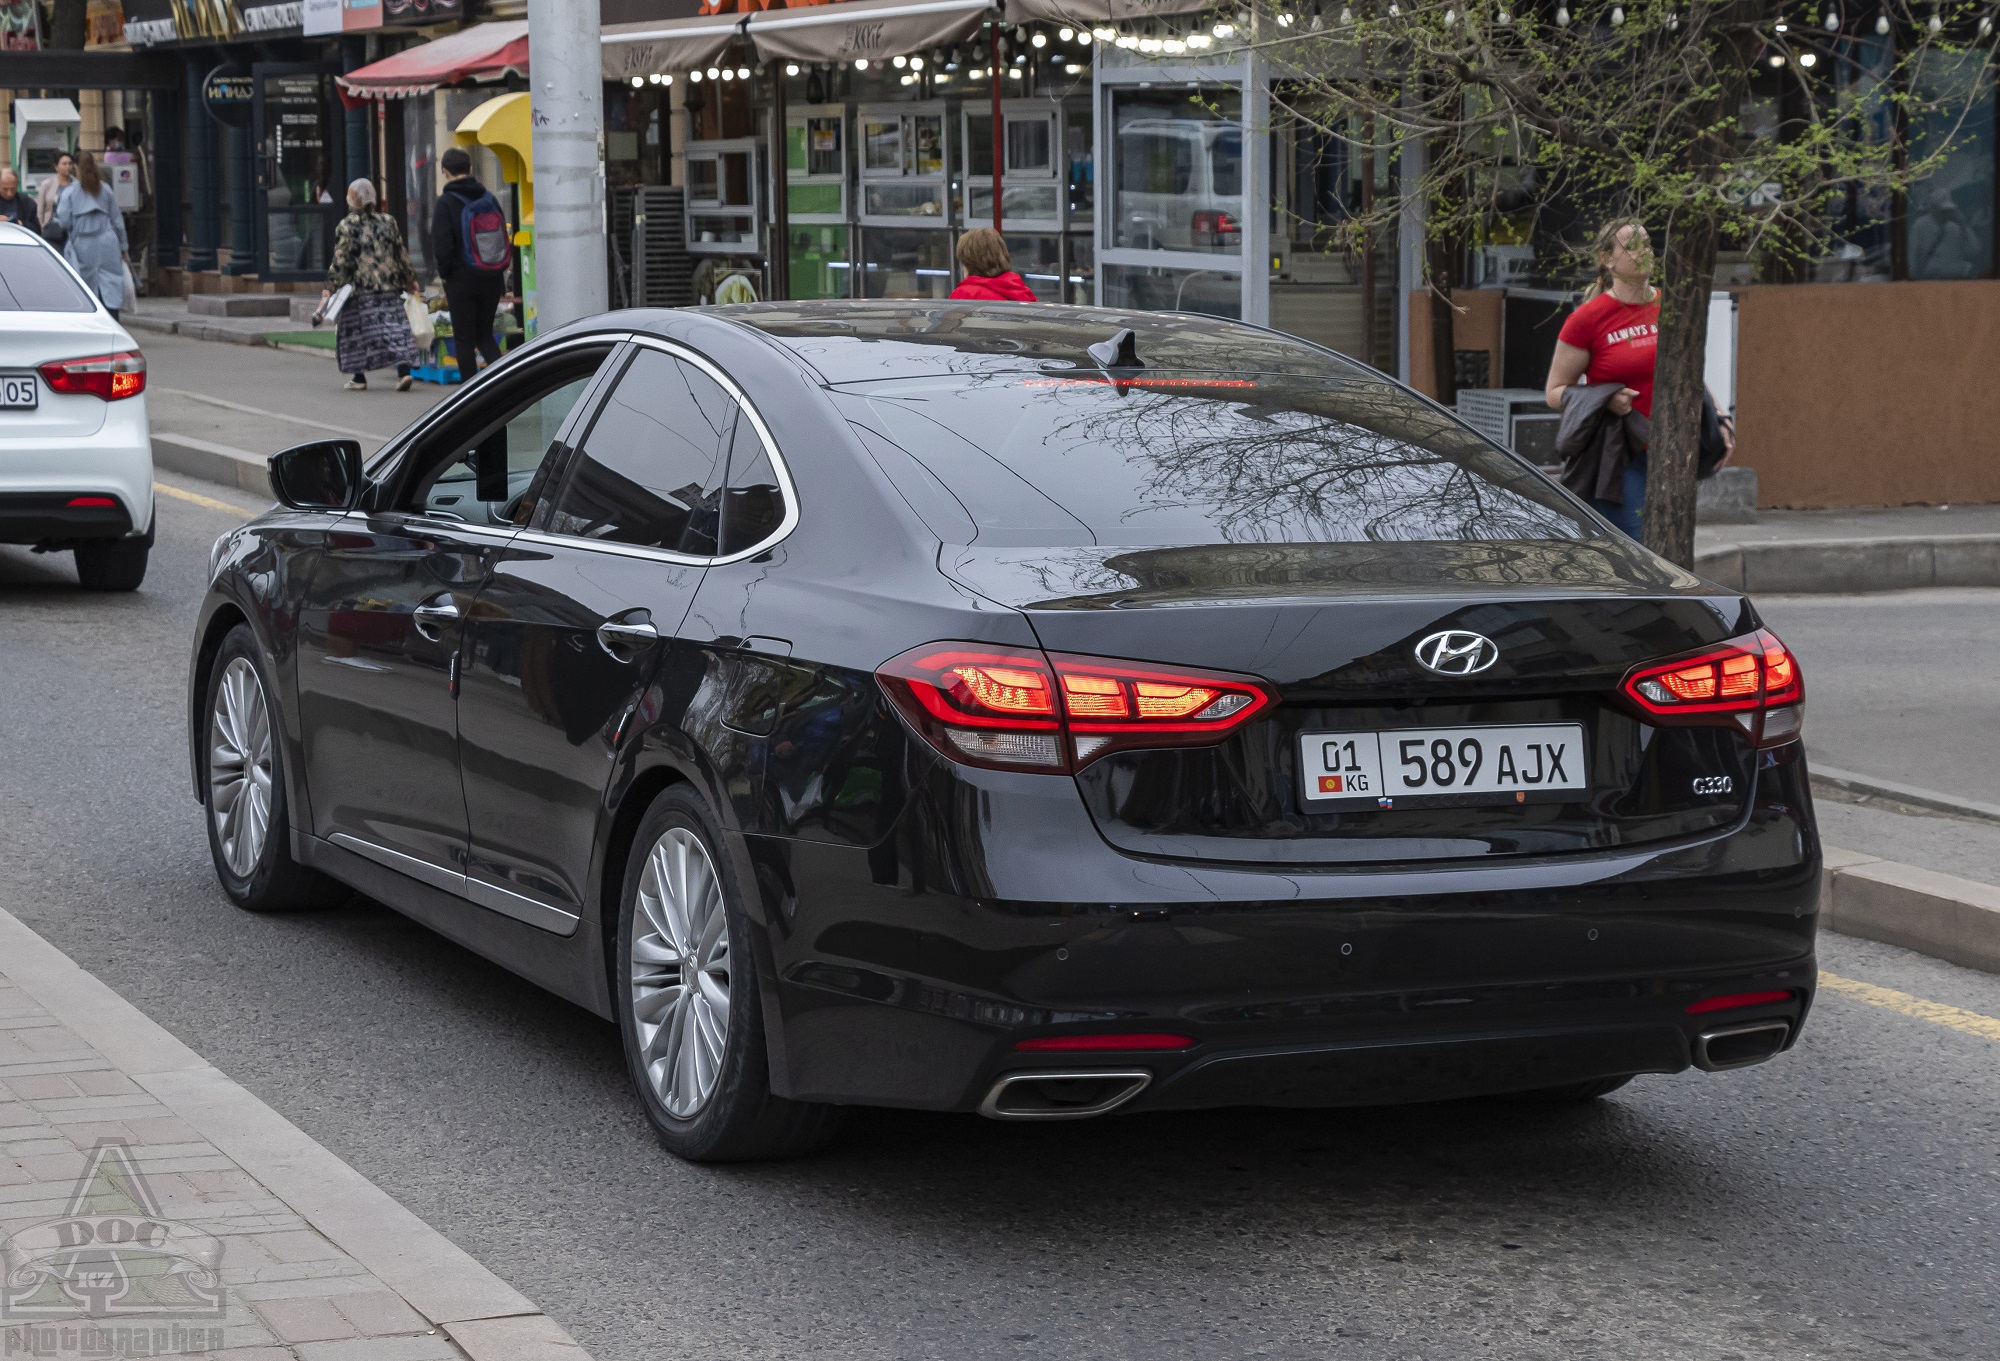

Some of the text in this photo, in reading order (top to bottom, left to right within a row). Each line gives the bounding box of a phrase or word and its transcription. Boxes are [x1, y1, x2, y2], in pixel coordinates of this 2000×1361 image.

[1606, 324, 1648, 345] ALWAYS
[1650, 323, 1658, 334] B
[6, 381, 33, 403] 05
[1322, 740, 1362, 772] 01
[1399, 738, 1568, 788] 589 AJX
[1346, 775, 1369, 792] KG
[1693, 775, 1733, 795] G330
